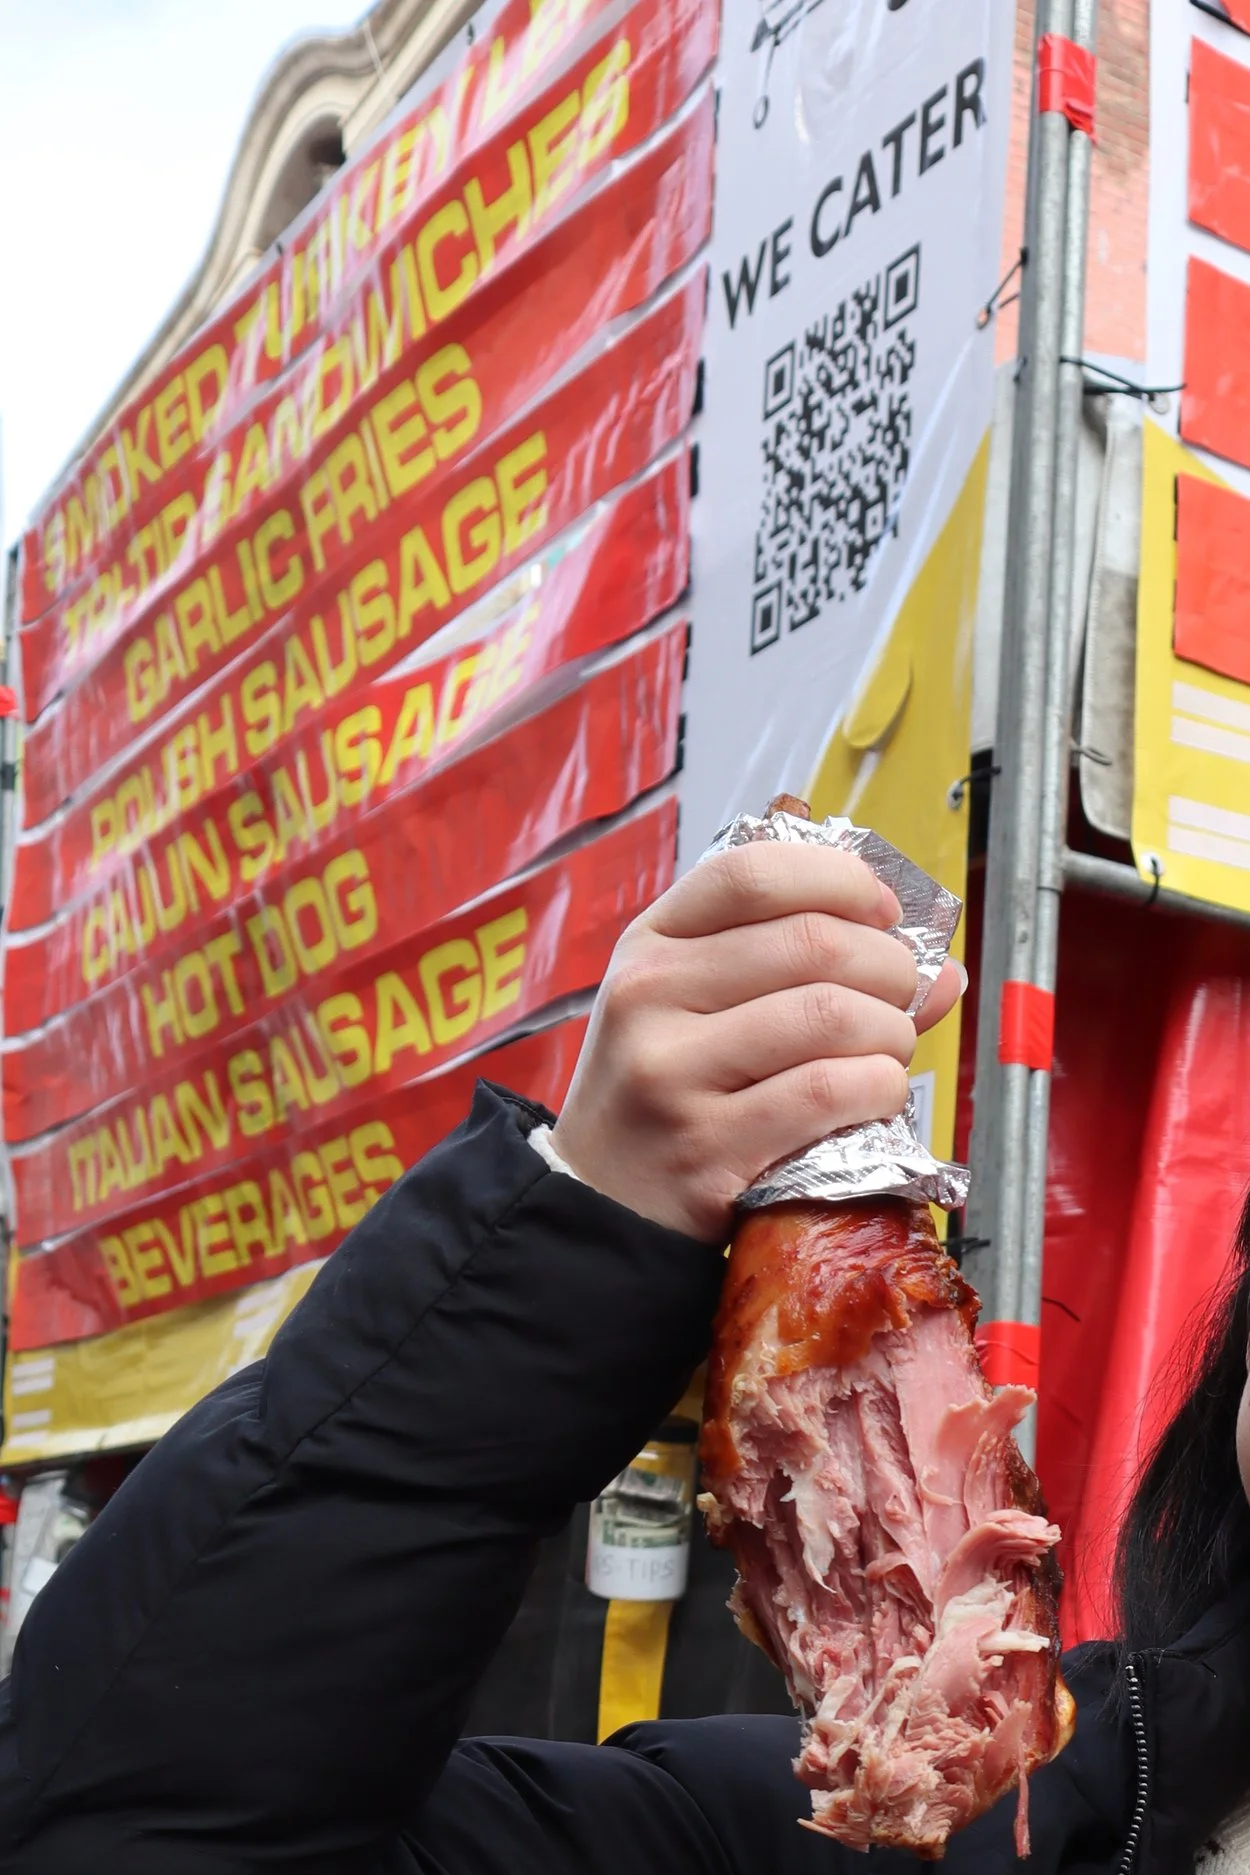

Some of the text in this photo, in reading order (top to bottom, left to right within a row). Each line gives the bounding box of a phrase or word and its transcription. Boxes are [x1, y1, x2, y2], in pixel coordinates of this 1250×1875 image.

[202, 38, 630, 546] SANDWICHES
[722, 57, 987, 330] WE CATER
[44, 343, 229, 592] SMOKED
[122, 343, 482, 723] GARLIC FRIES
[240, 431, 547, 756] SAUSAGE
[82, 602, 540, 983] CAJUN SAUSAGE
[67, 908, 529, 1210] ITALIAN SAUSAGE
[142, 849, 379, 1057] HOT DOG
[102, 1120, 406, 1308] BEVERAGES
